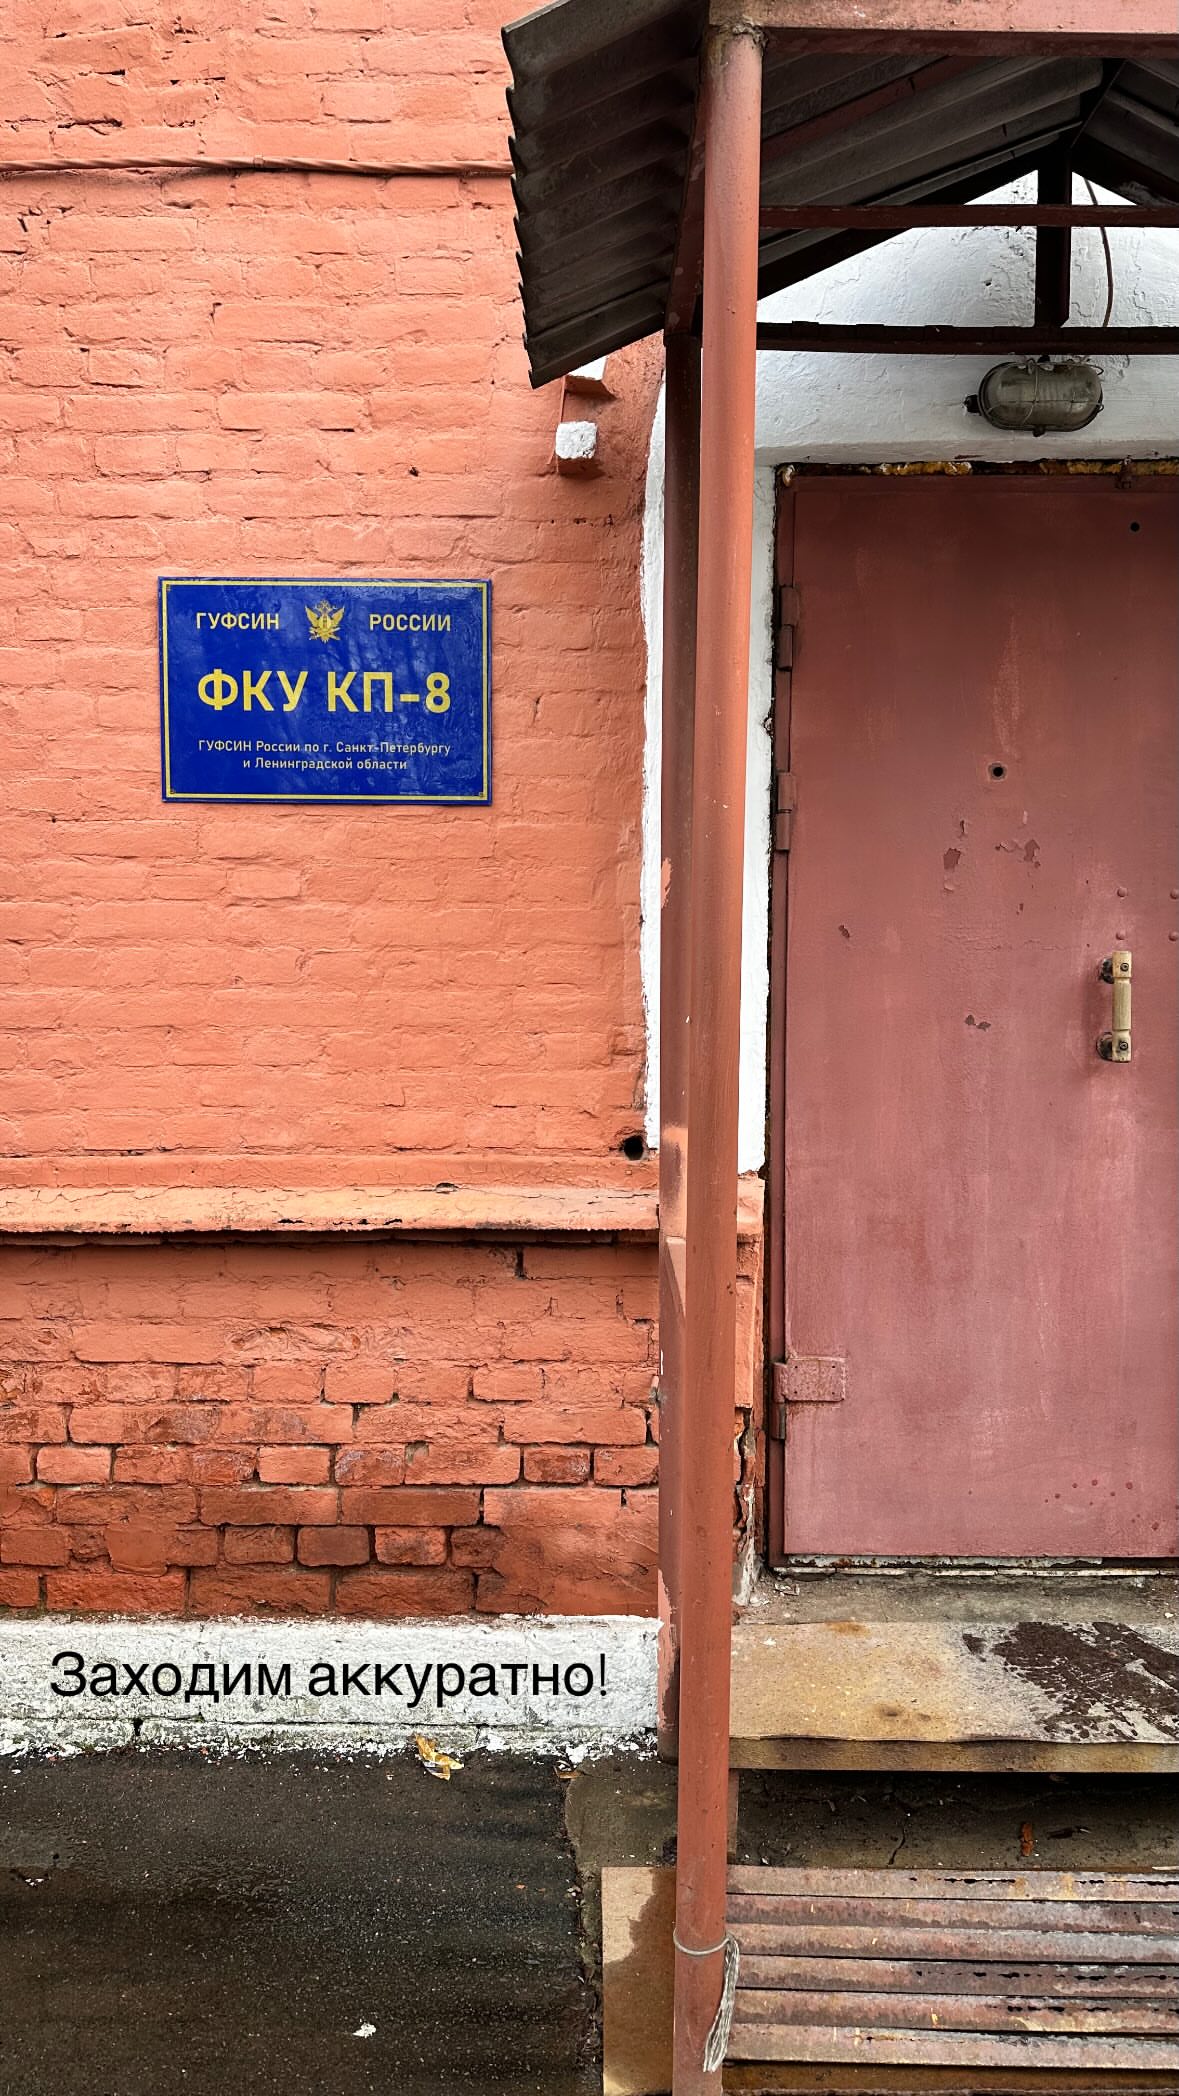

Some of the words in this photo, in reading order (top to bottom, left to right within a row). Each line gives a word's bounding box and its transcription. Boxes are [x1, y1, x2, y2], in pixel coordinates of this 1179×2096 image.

[196, 612, 279, 630] ГУФСИН
[369, 614, 451, 631] РОССИИ
[198, 668, 308, 712] ФКУ
[327, 671, 451, 713] КП-8
[198, 740, 251, 752] ГУФСИН
[256, 741, 300, 753] России
[305, 743, 320, 753] по
[324, 744, 332, 753] г.
[336, 742, 450, 757] Санкт-Петербургу
[244, 760, 251, 769] и
[255, 757, 353, 772] Ленинградской
[357, 758, 407, 770] области
